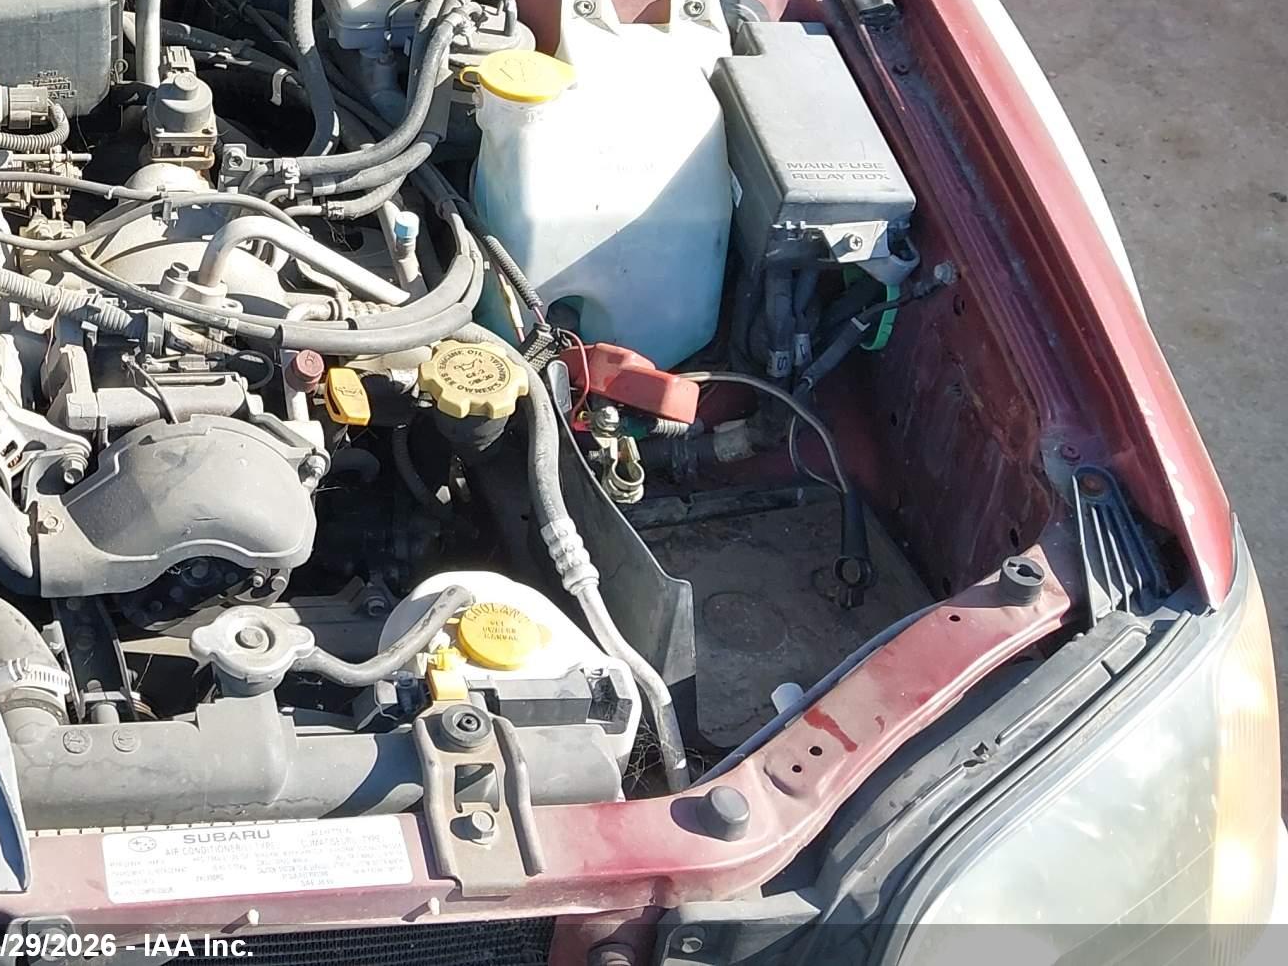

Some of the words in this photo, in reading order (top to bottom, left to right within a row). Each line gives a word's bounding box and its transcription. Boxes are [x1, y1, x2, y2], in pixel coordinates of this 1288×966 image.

[786, 162, 834, 170] MAIN
[838, 162, 886, 170] FUSE
[439, 350, 465, 370] ENGINE
[467, 349, 483, 357] OIL
[441, 372, 456, 386] SEE
[183, 829, 270, 844] SUBARU
